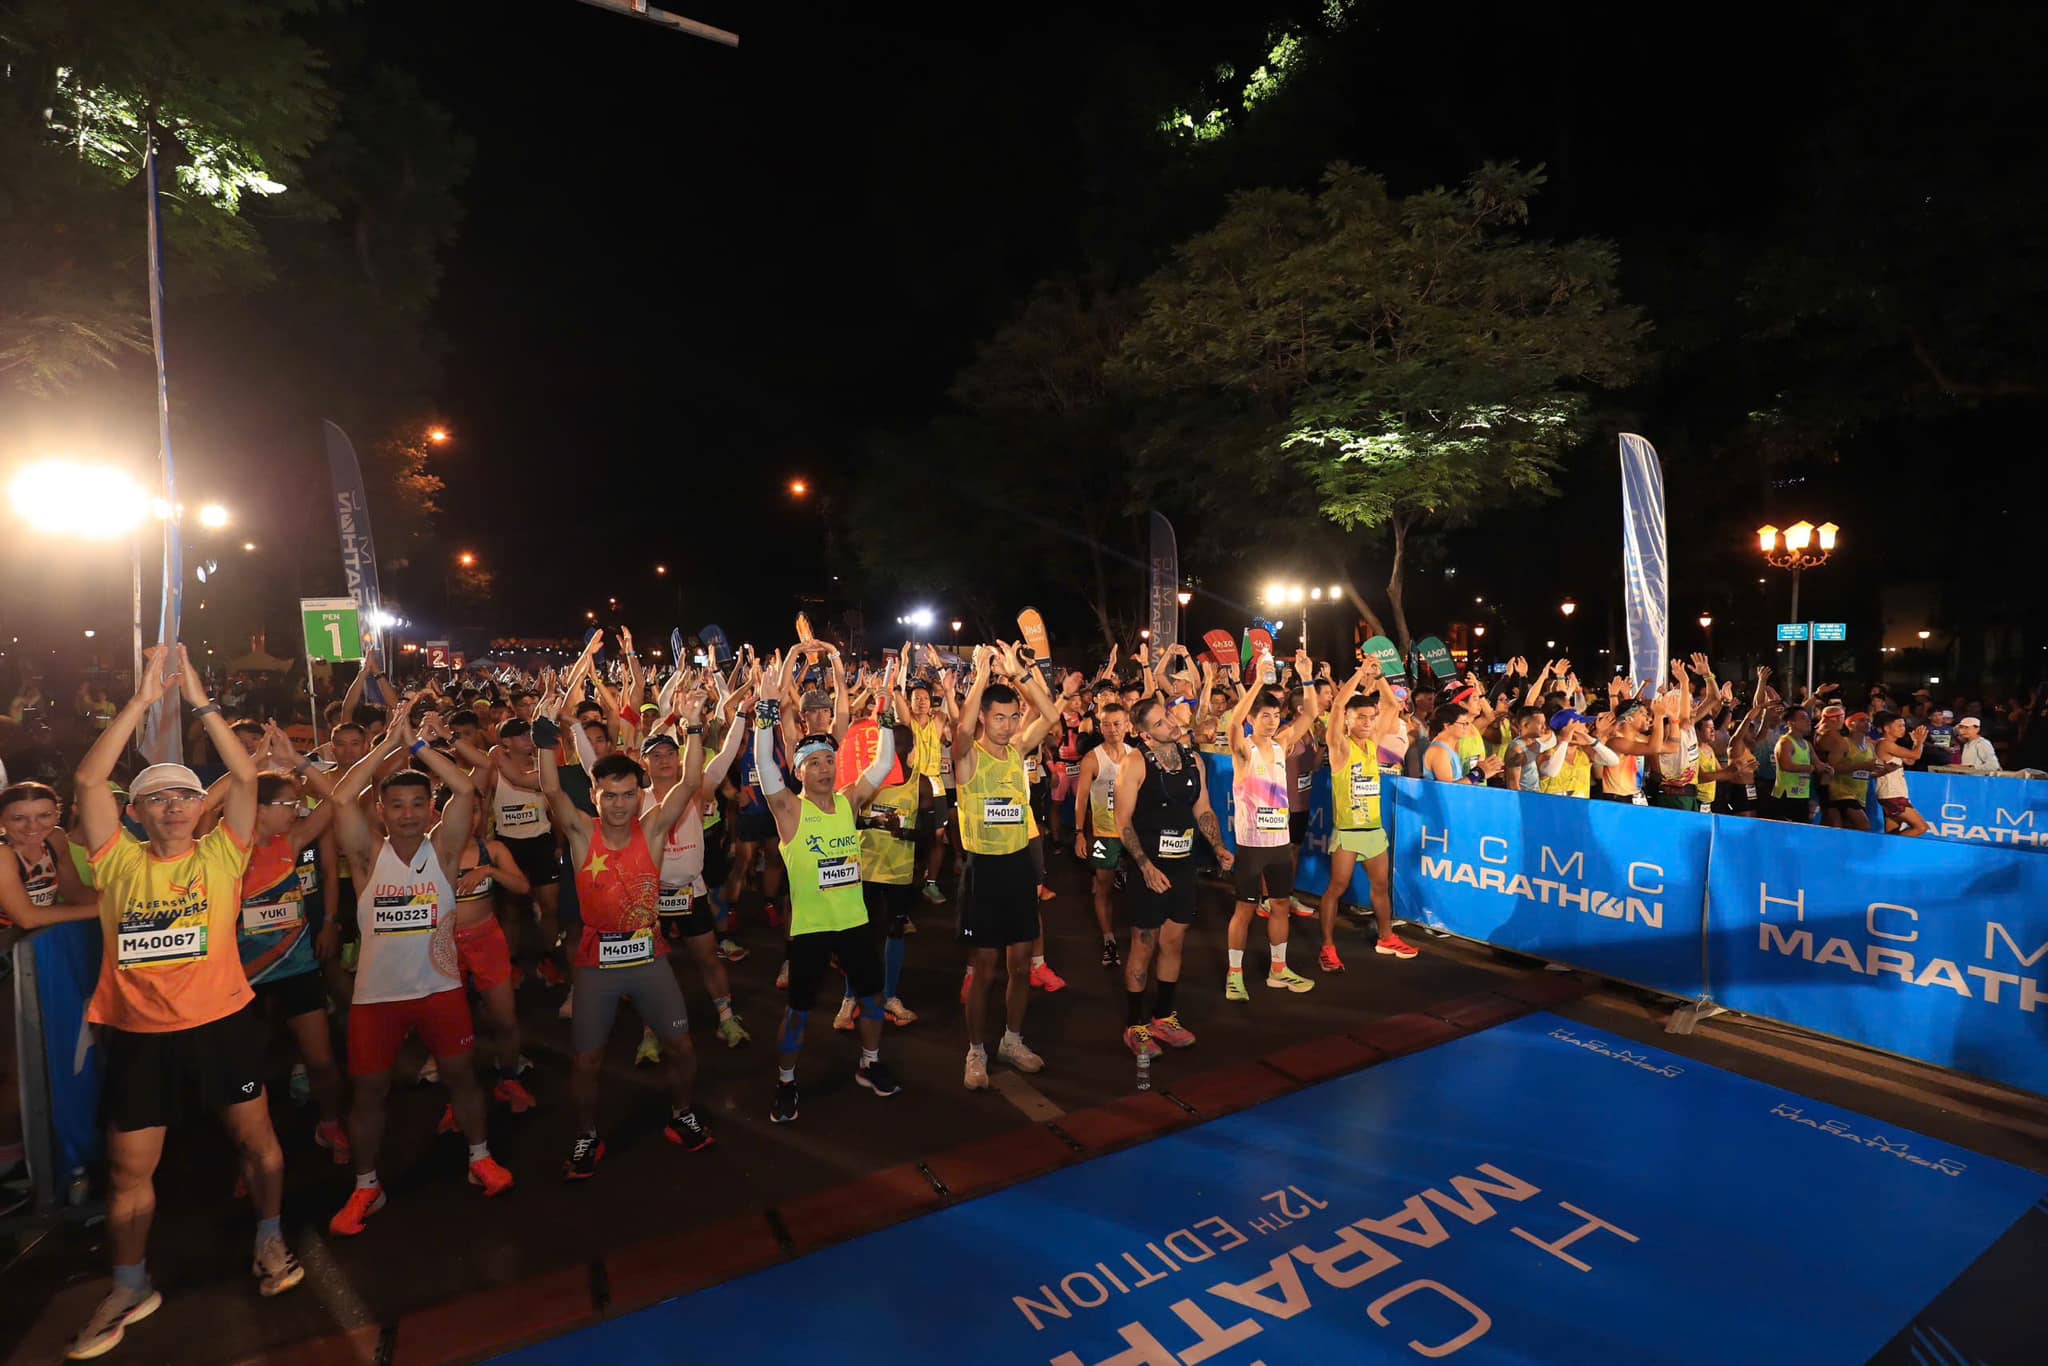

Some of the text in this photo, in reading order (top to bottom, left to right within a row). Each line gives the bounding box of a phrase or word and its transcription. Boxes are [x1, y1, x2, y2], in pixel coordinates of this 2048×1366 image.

[324, 623, 342, 657] 1
[432, 650, 444, 665] 2
[987, 808, 1019, 817] M40128
[828, 835, 856, 848] CNRC
[823, 867, 855, 880] M41677
[1421, 856, 1664, 929] MARATHON
[260, 908, 287, 920] YUKI
[376, 909, 429, 923] M40323
[123, 933, 195, 952] M40067
[1012, 1215, 1249, 1331] EDITION
